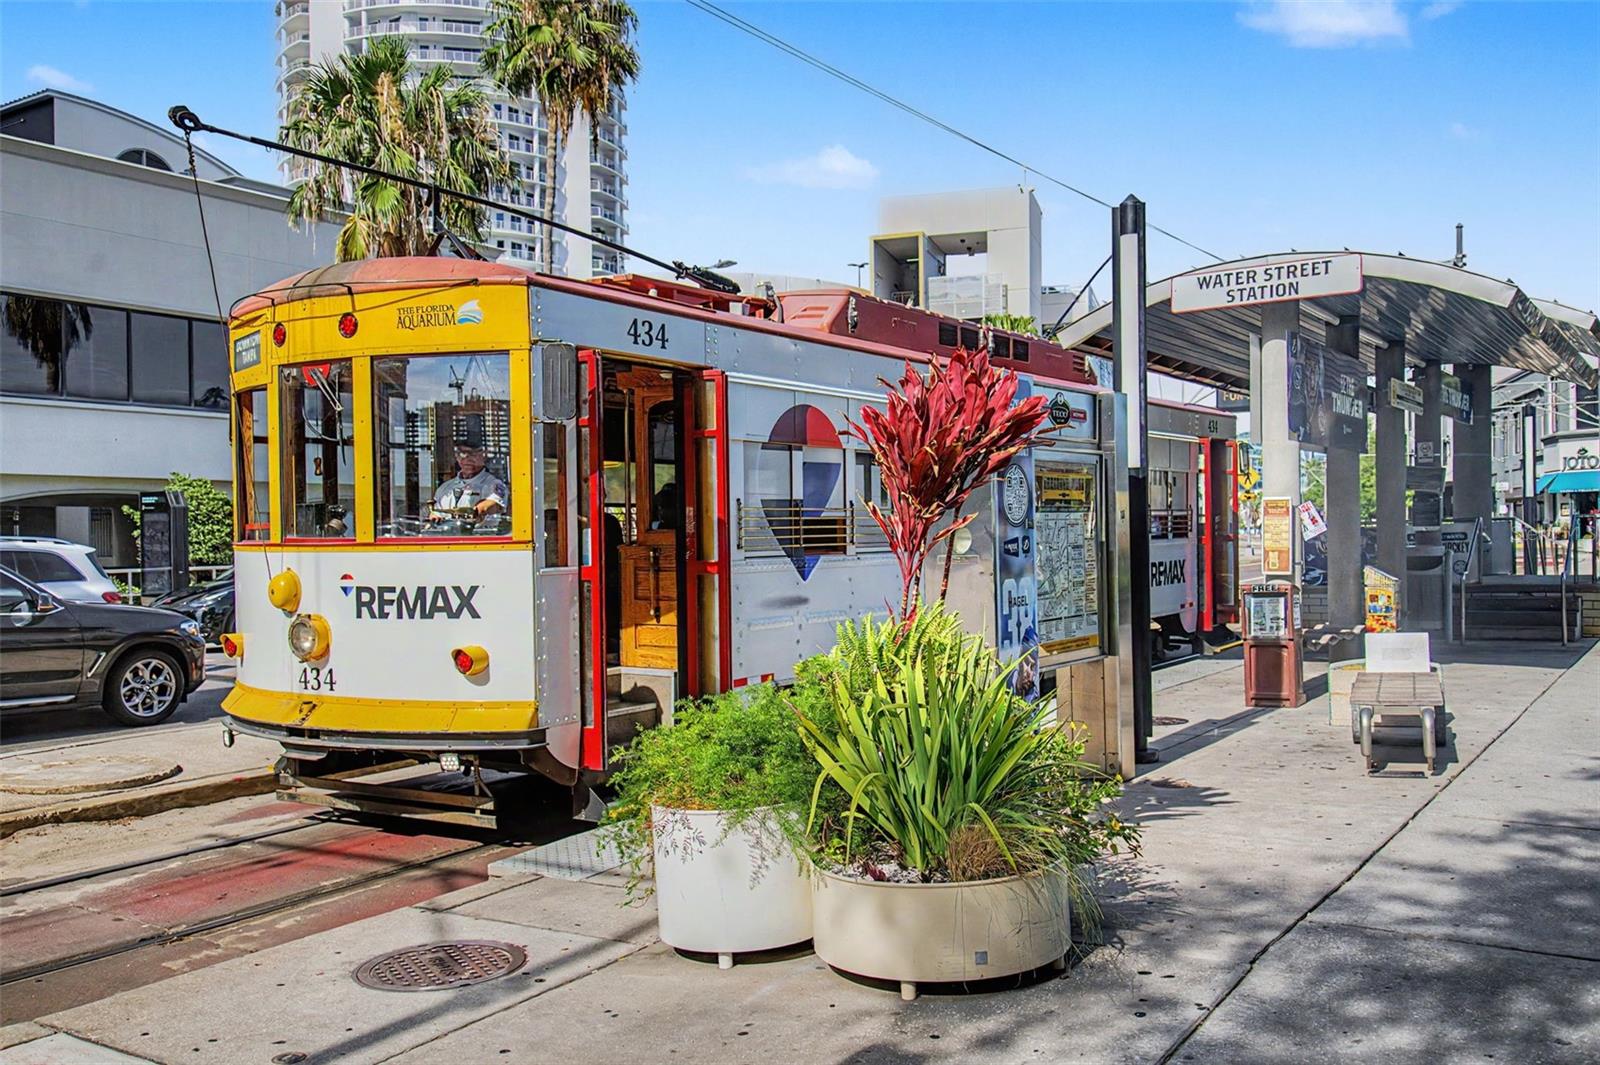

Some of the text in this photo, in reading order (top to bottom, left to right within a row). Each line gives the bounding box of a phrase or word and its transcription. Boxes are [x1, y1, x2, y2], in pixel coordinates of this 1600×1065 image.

[1197, 260, 1333, 290] WATER STREET
[1226, 281, 1300, 303] STATION
[397, 304, 455, 315] THE FLORIDA
[396, 312, 457, 330] AQUARIUM
[627, 318, 669, 350] 434
[1208, 420, 1218, 433] 434
[299, 667, 336, 691] 434
